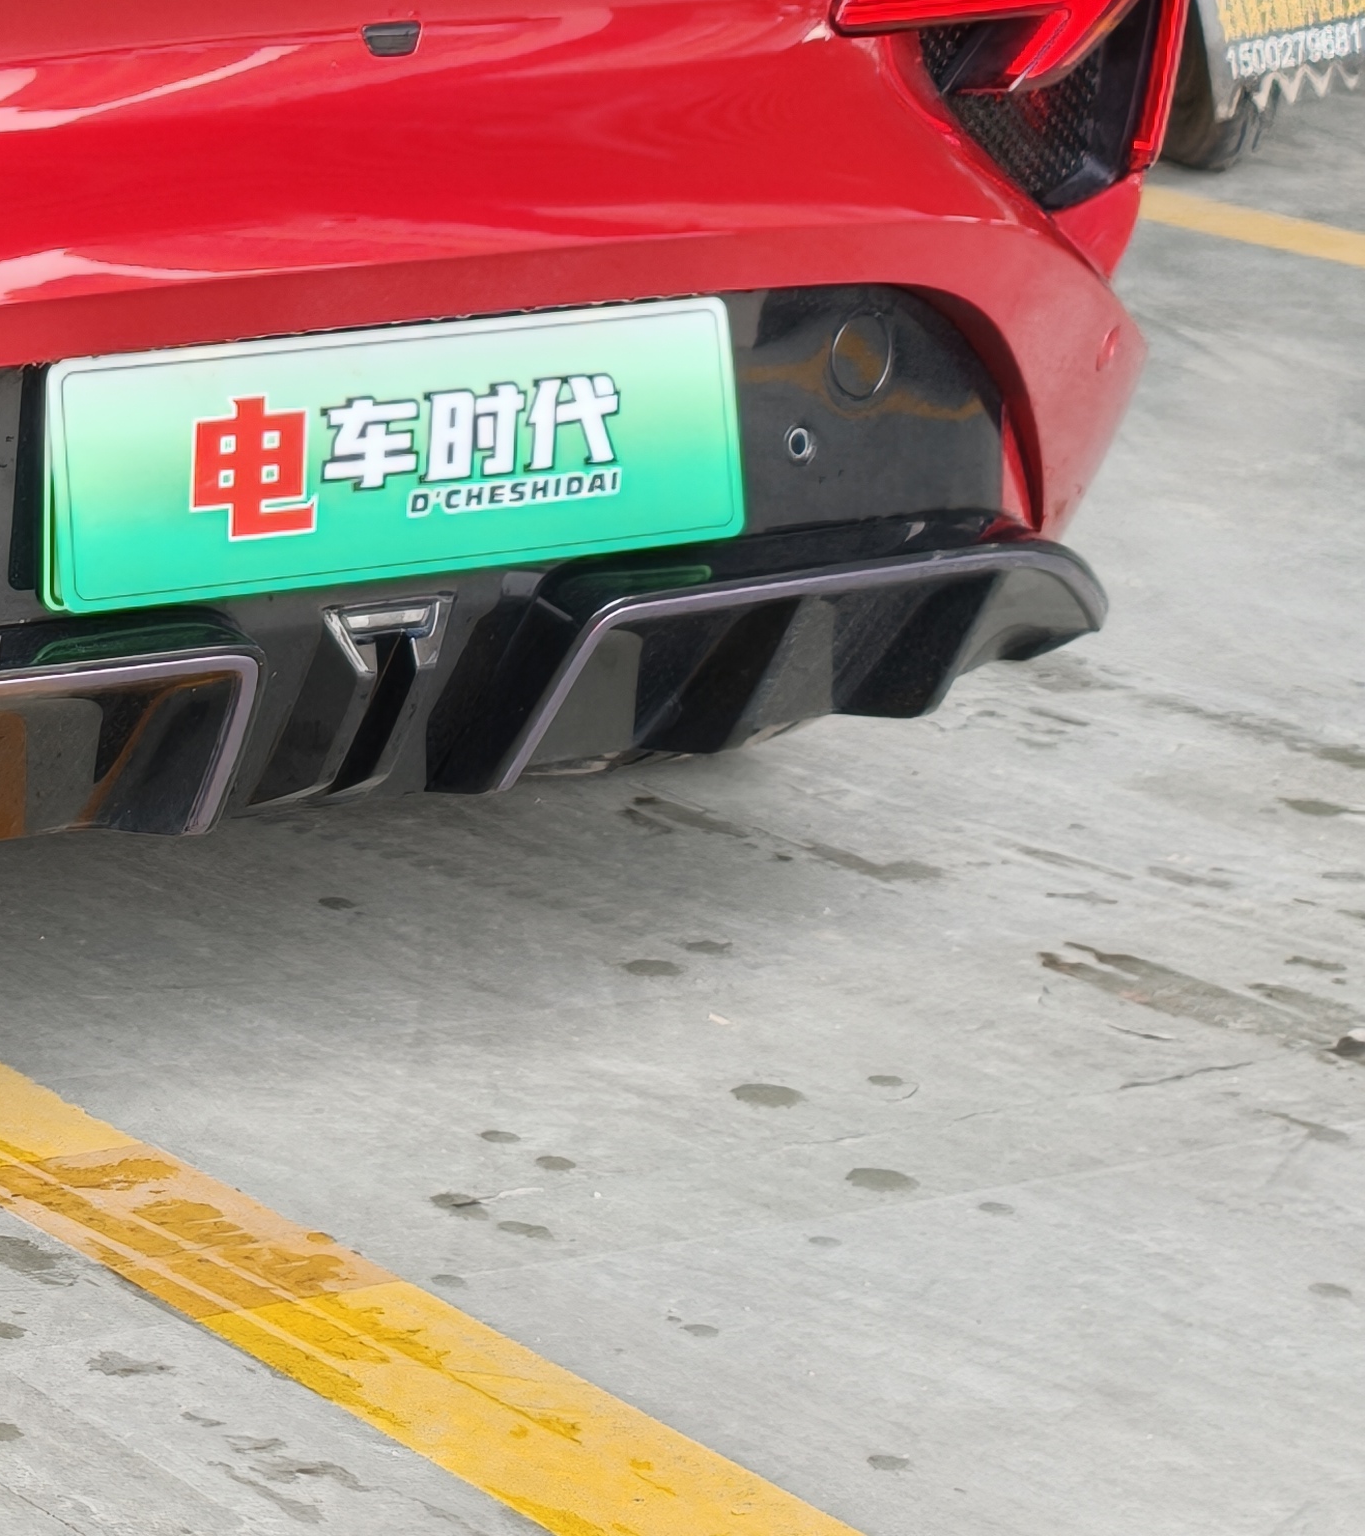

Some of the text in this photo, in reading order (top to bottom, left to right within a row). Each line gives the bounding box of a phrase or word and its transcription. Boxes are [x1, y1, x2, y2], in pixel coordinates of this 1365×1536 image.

[189, 372, 620, 542] 电车时代
[410, 469, 619, 514] D'CHESHIDAI
